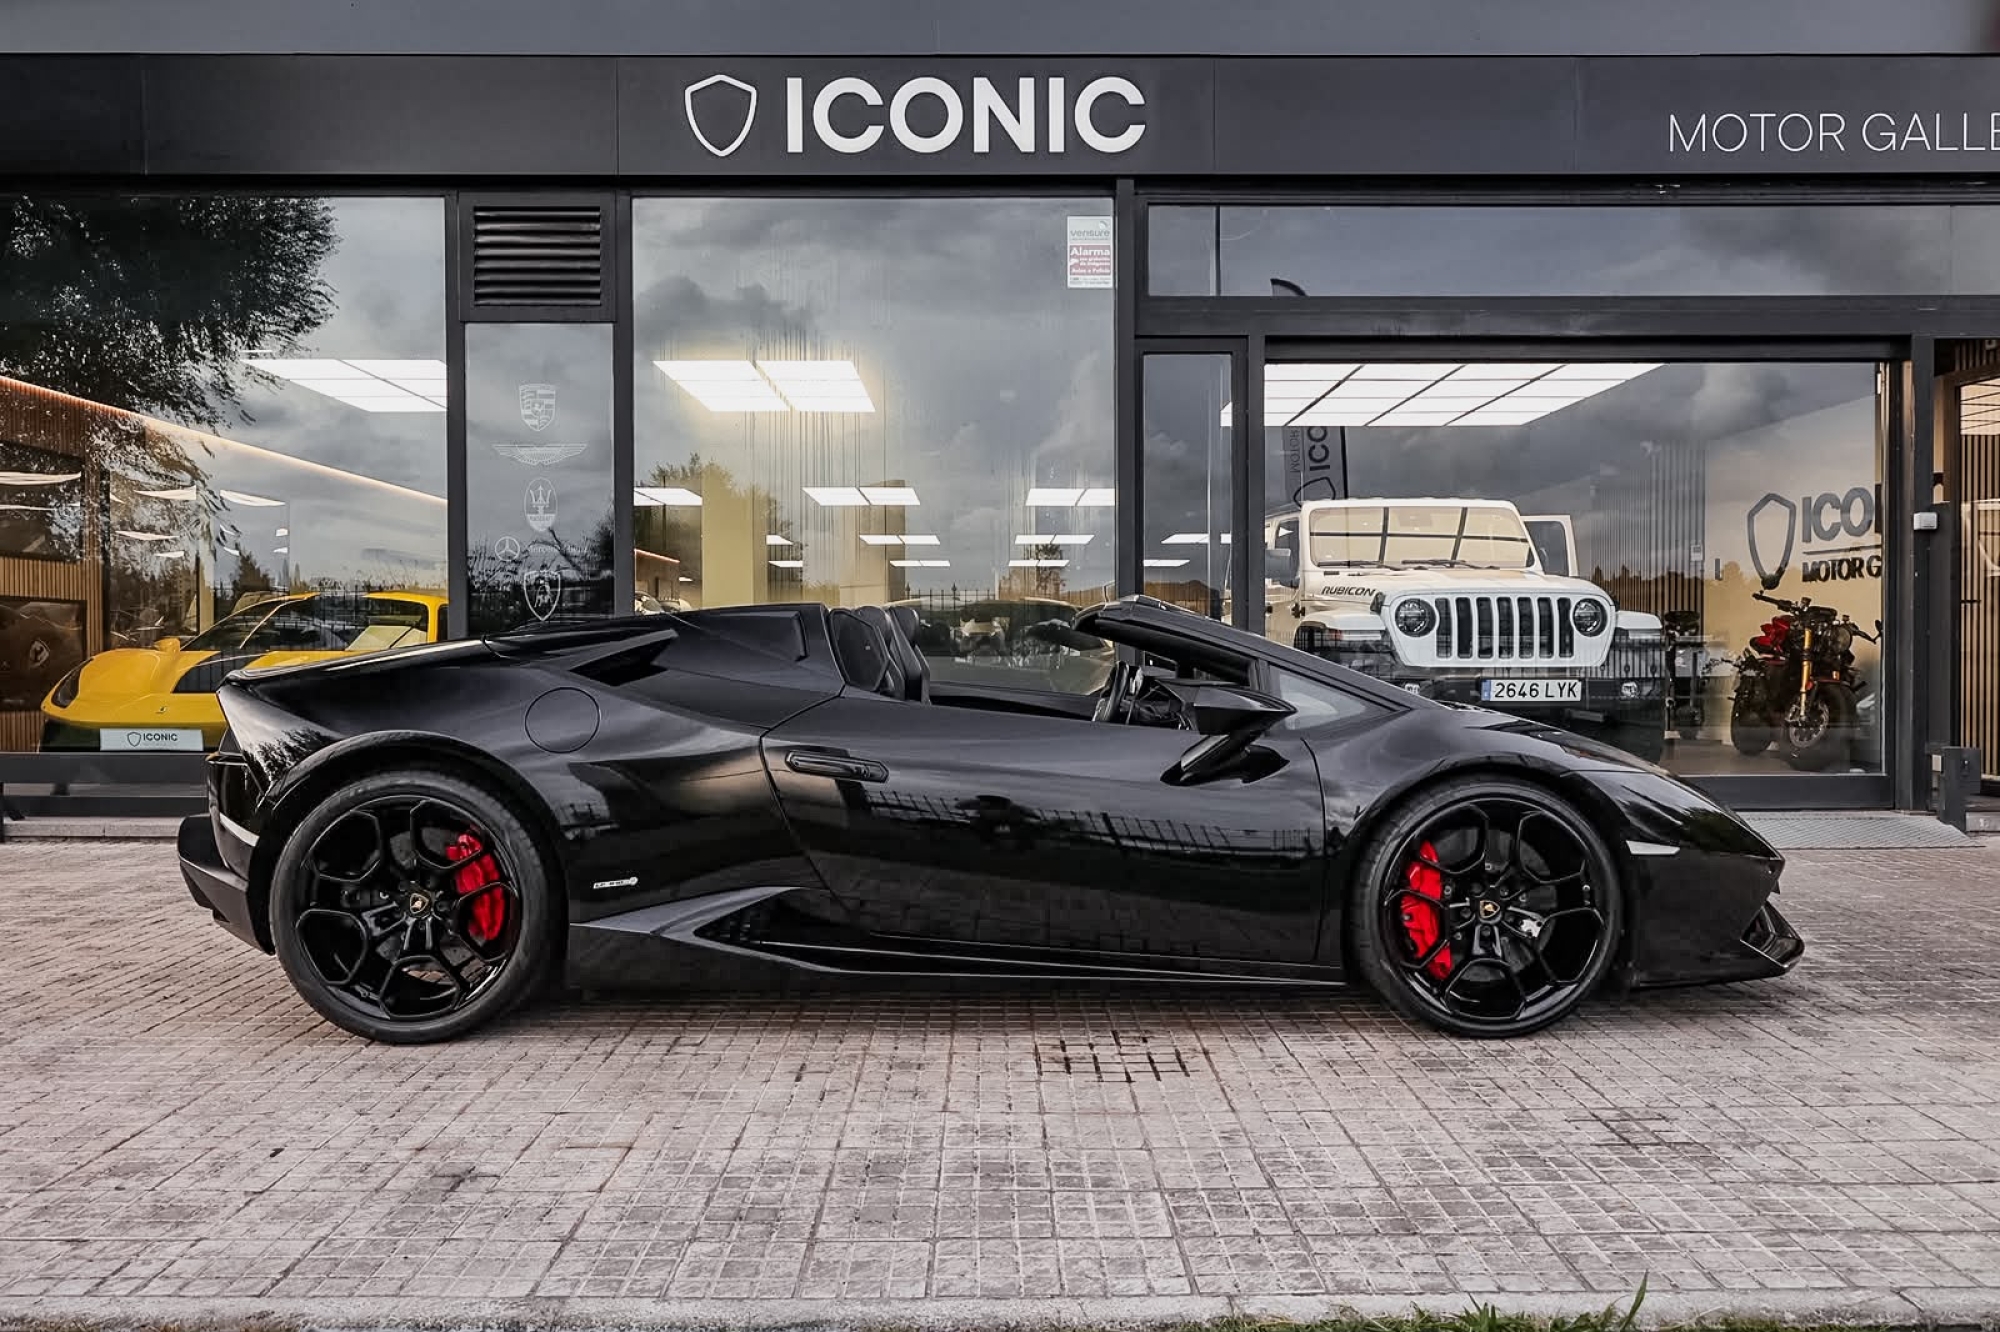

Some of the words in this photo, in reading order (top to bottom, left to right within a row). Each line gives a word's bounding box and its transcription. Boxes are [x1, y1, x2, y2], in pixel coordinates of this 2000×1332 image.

[786, 76, 1146, 153] ICONIC
[1669, 113, 1846, 152] MOTOR
[1070, 246, 1110, 256] Alarma
[1802, 557, 1865, 582] MOTOR
[1321, 585, 1376, 597] RUBICON
[1494, 682, 1540, 699] 2646
[1545, 682, 1578, 698] LYK
[143, 733, 178, 742] ICONIC
